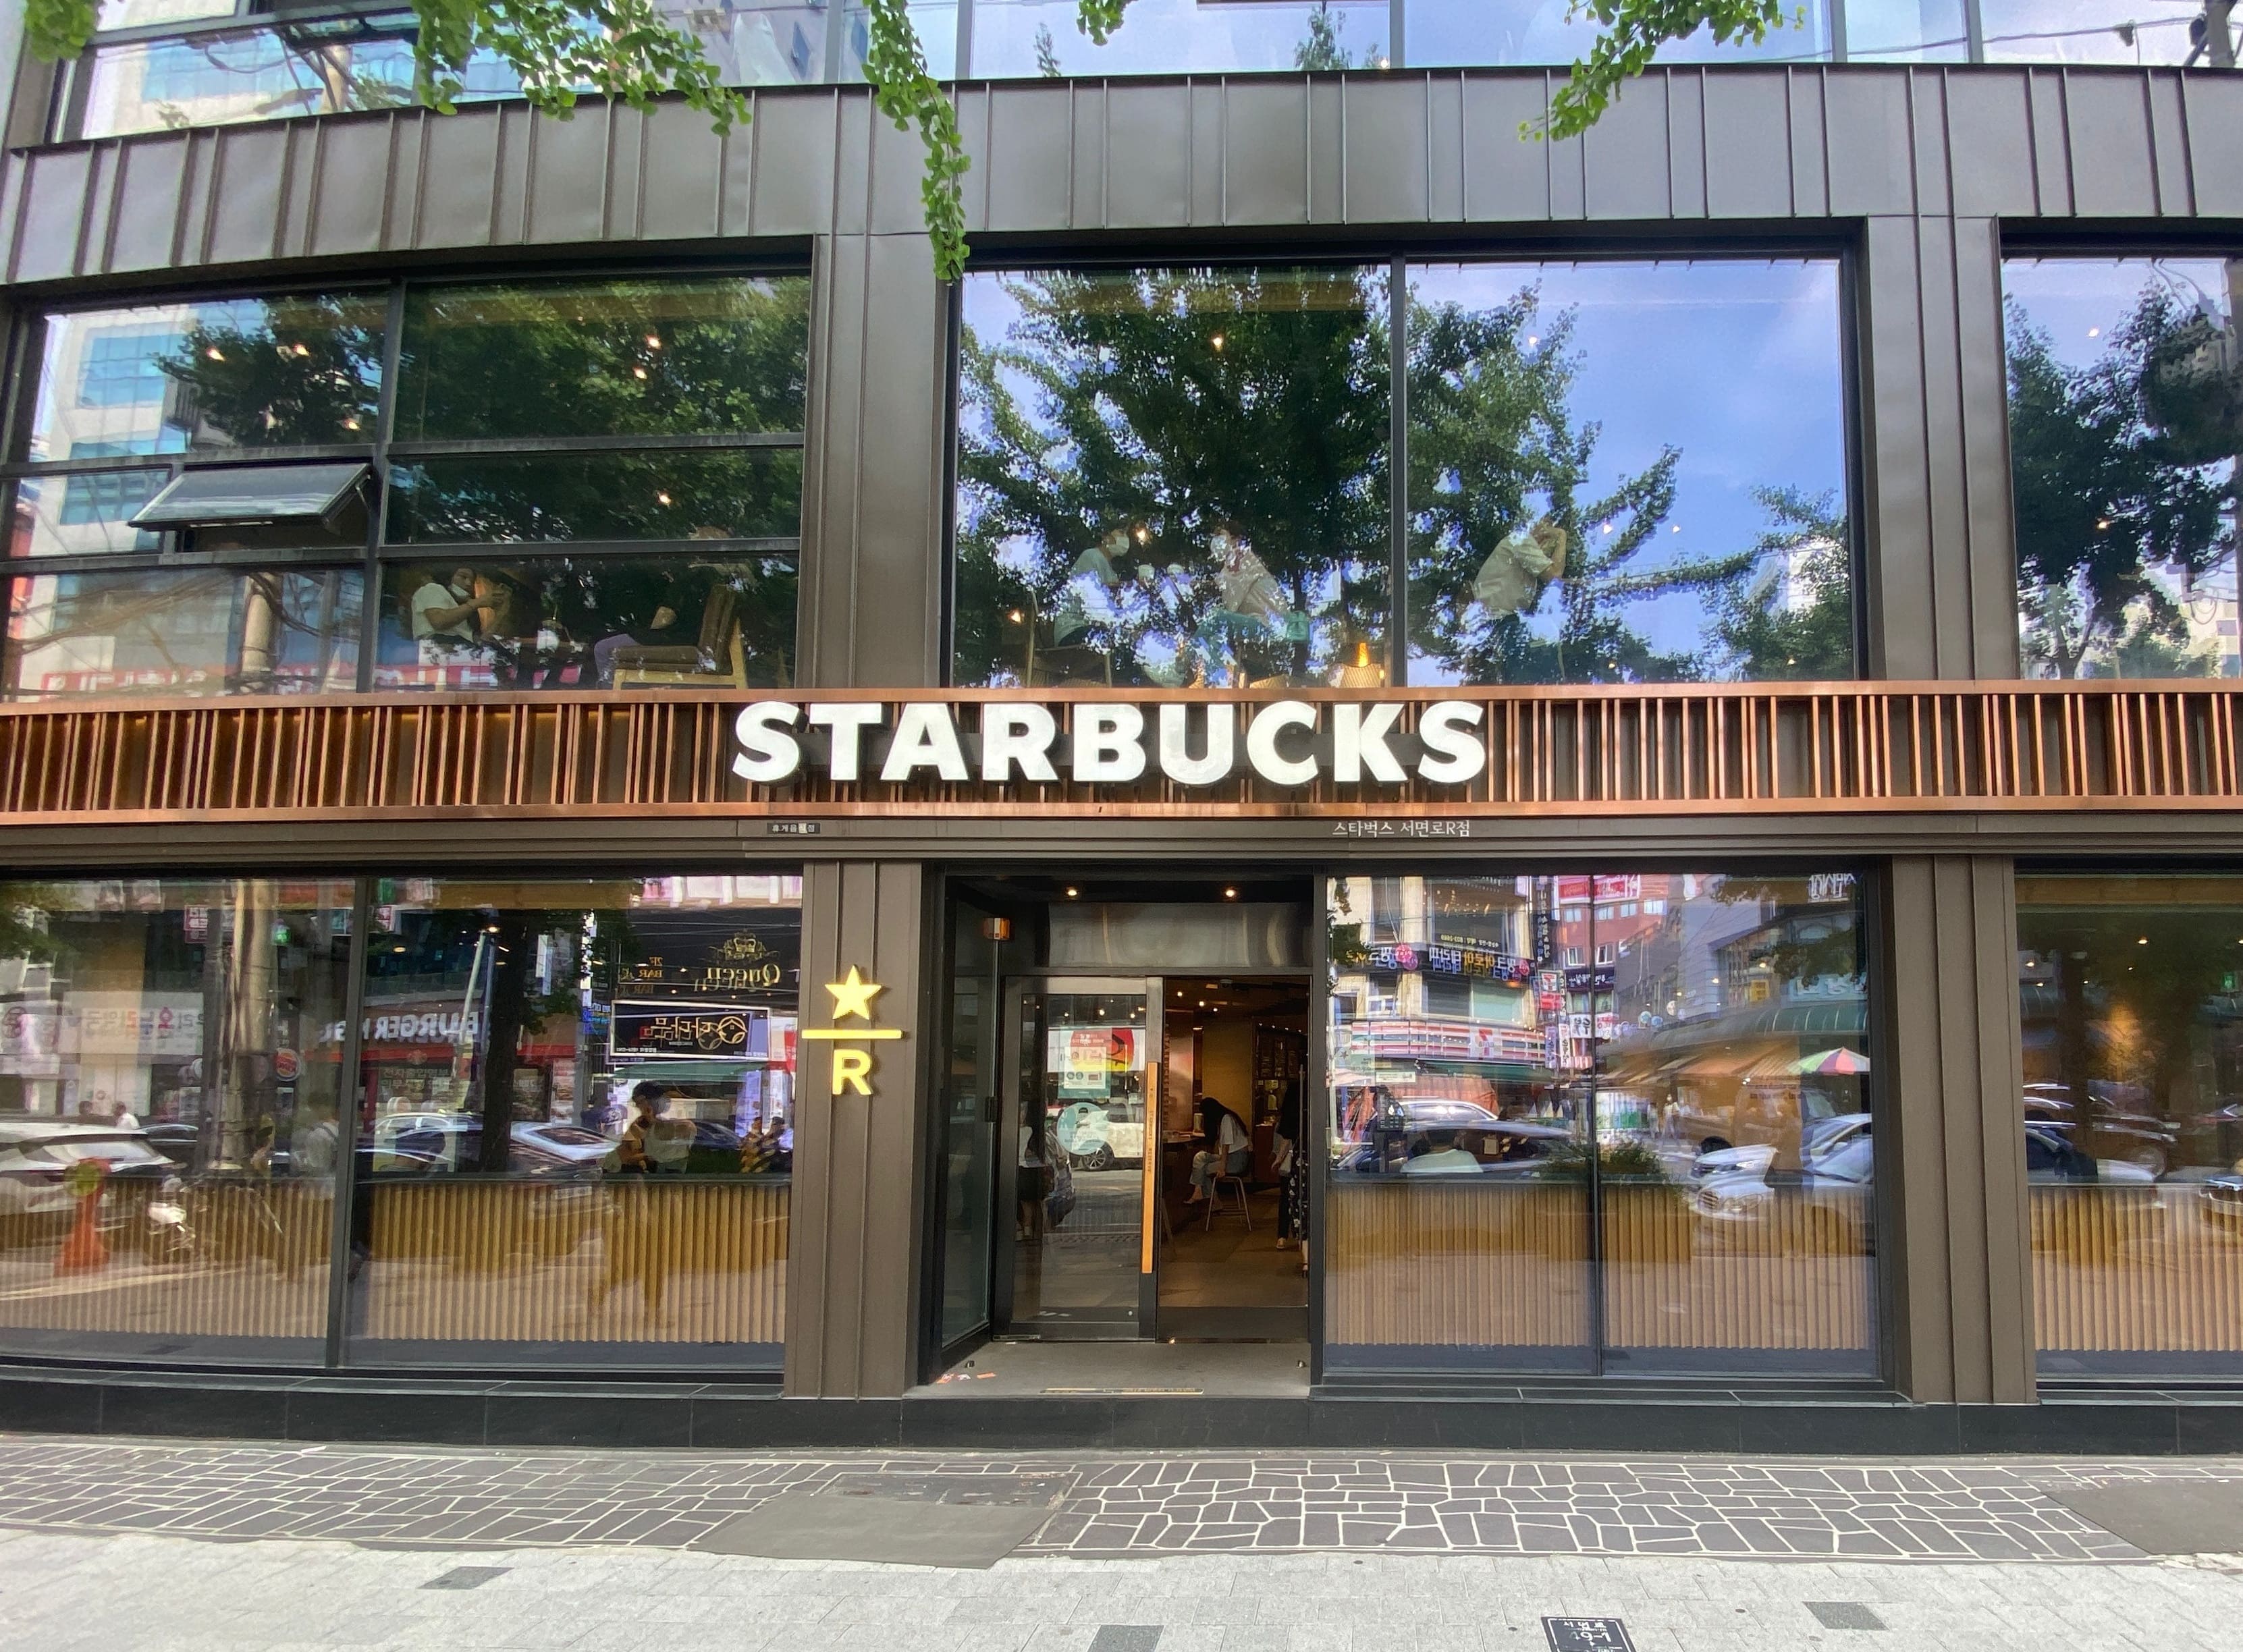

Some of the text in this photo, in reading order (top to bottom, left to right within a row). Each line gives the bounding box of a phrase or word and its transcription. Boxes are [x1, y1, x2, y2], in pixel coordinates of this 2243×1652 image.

[731, 699, 1486, 786] STARBUCKS
[1332, 820, 1470, 837] 스타벅스 서면로R점
[832, 1049, 873, 1096] R
